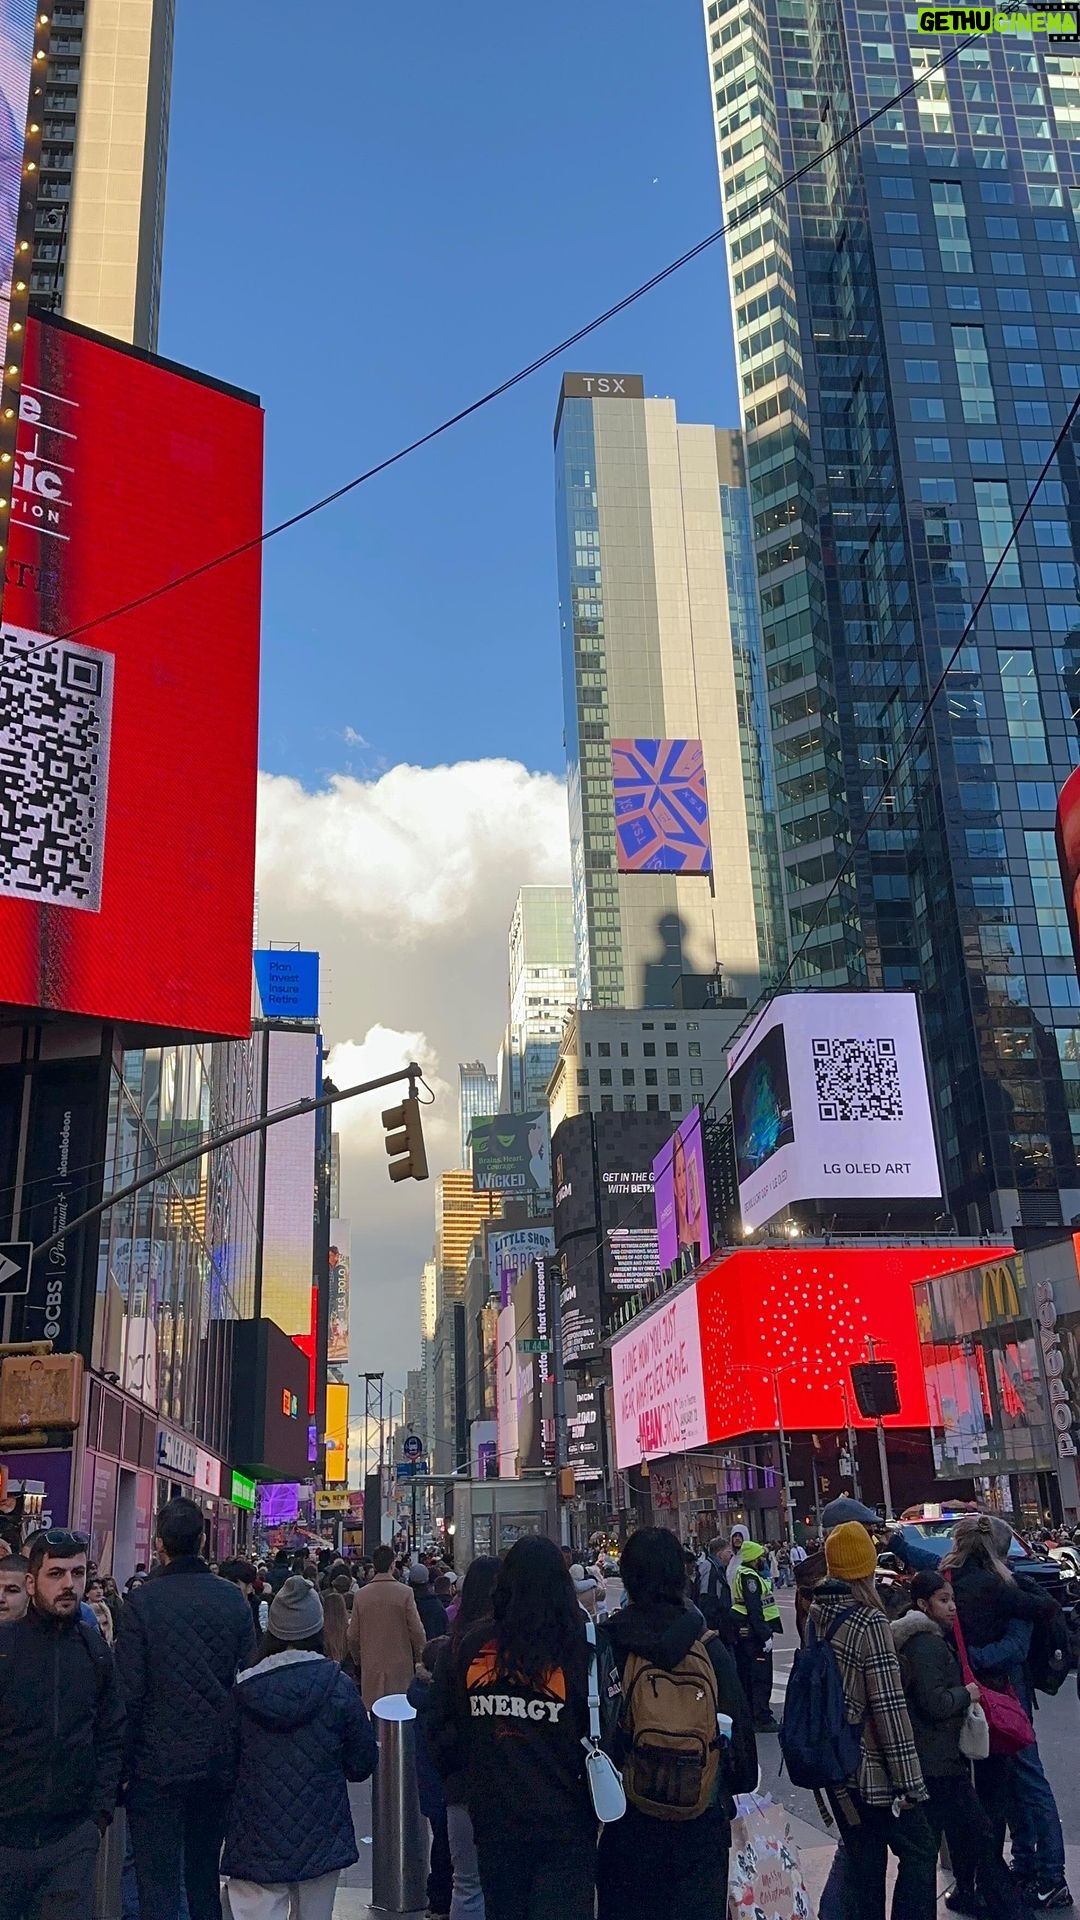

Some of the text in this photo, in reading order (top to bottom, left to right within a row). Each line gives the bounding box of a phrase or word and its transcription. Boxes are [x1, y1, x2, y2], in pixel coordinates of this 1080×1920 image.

[582, 378, 625, 393] TSX
[269, 962, 291, 971] Plan
[269, 973, 299, 982] Invest
[269, 984, 299, 993] Insure
[268, 995, 298, 1004] Retire
[823, 1163, 912, 1175] LG OLED ART
[602, 1172, 619, 1182] GET
[620, 1172, 630, 1182] IN
[631, 1172, 648, 1182] THE
[608, 1184, 629, 1194] WITH
[45, 1280, 63, 1321] CBS
[57, 1110, 72, 1177] nickelodeon
[495, 1232, 525, 1252] LITTLE
[337, 1268, 346, 1293] POLO
[535, 1261, 546, 1311] transcend
[537, 1312, 547, 1334] that
[469, 1694, 565, 1723] ENERGY
